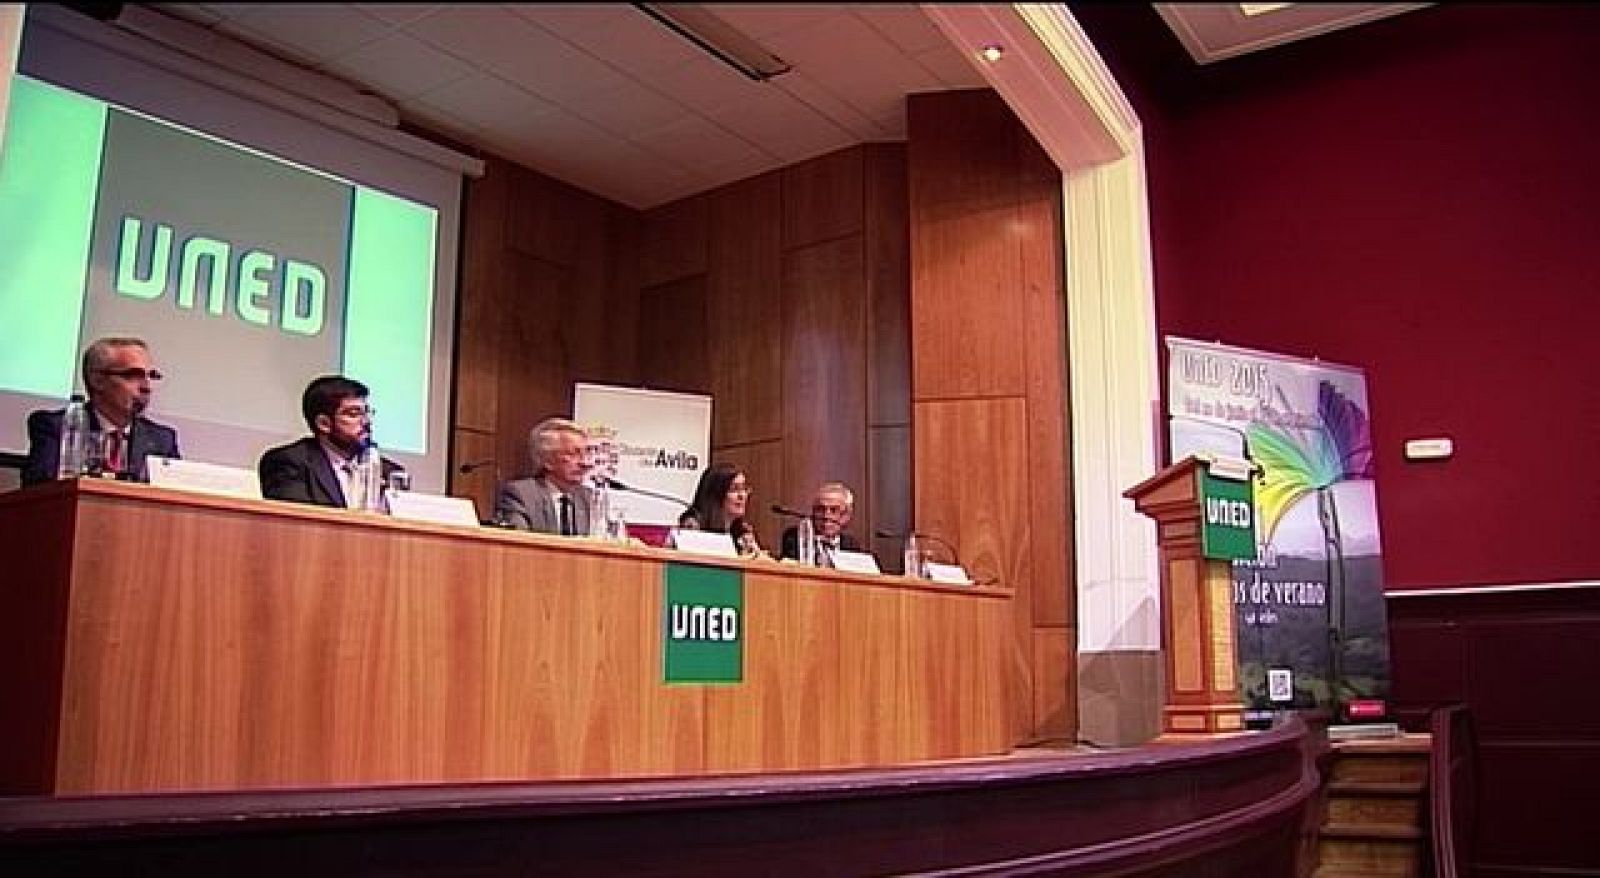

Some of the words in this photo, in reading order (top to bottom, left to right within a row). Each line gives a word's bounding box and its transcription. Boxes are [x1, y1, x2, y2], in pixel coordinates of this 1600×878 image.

[117, 216, 326, 336] UNED
[1206, 497, 1251, 527] UNED
[1250, 572, 1271, 604] de
[1272, 581, 1326, 605] verano
[672, 603, 738, 641] UNED
